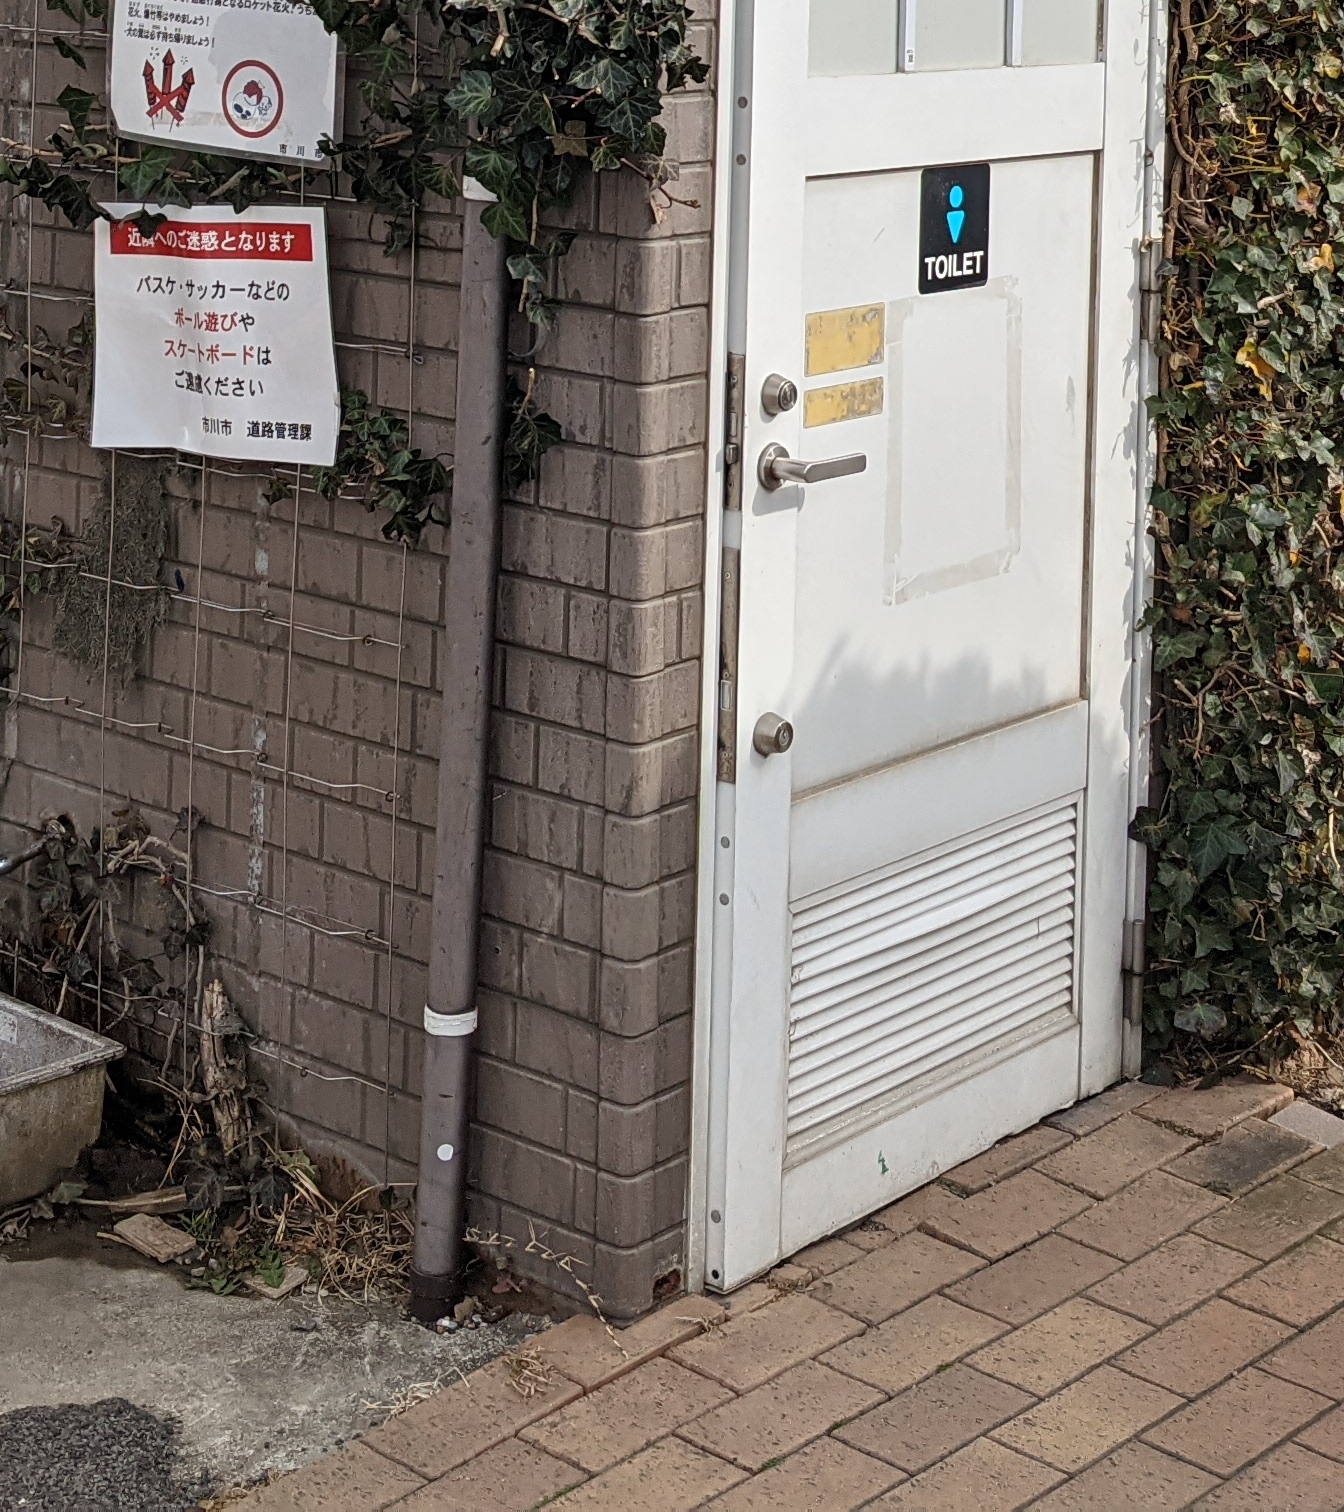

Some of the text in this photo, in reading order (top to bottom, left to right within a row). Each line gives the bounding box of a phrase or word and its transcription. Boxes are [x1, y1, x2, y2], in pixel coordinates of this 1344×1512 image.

[924, 250, 985, 280] TOILET
[136, 275, 290, 301] バスケ・サッカーなどの
[174, 308, 255, 332] ボール遊びや
[164, 339, 272, 365] スケートボードは
[201, 416, 312, 441] 市川市 道路管理課
